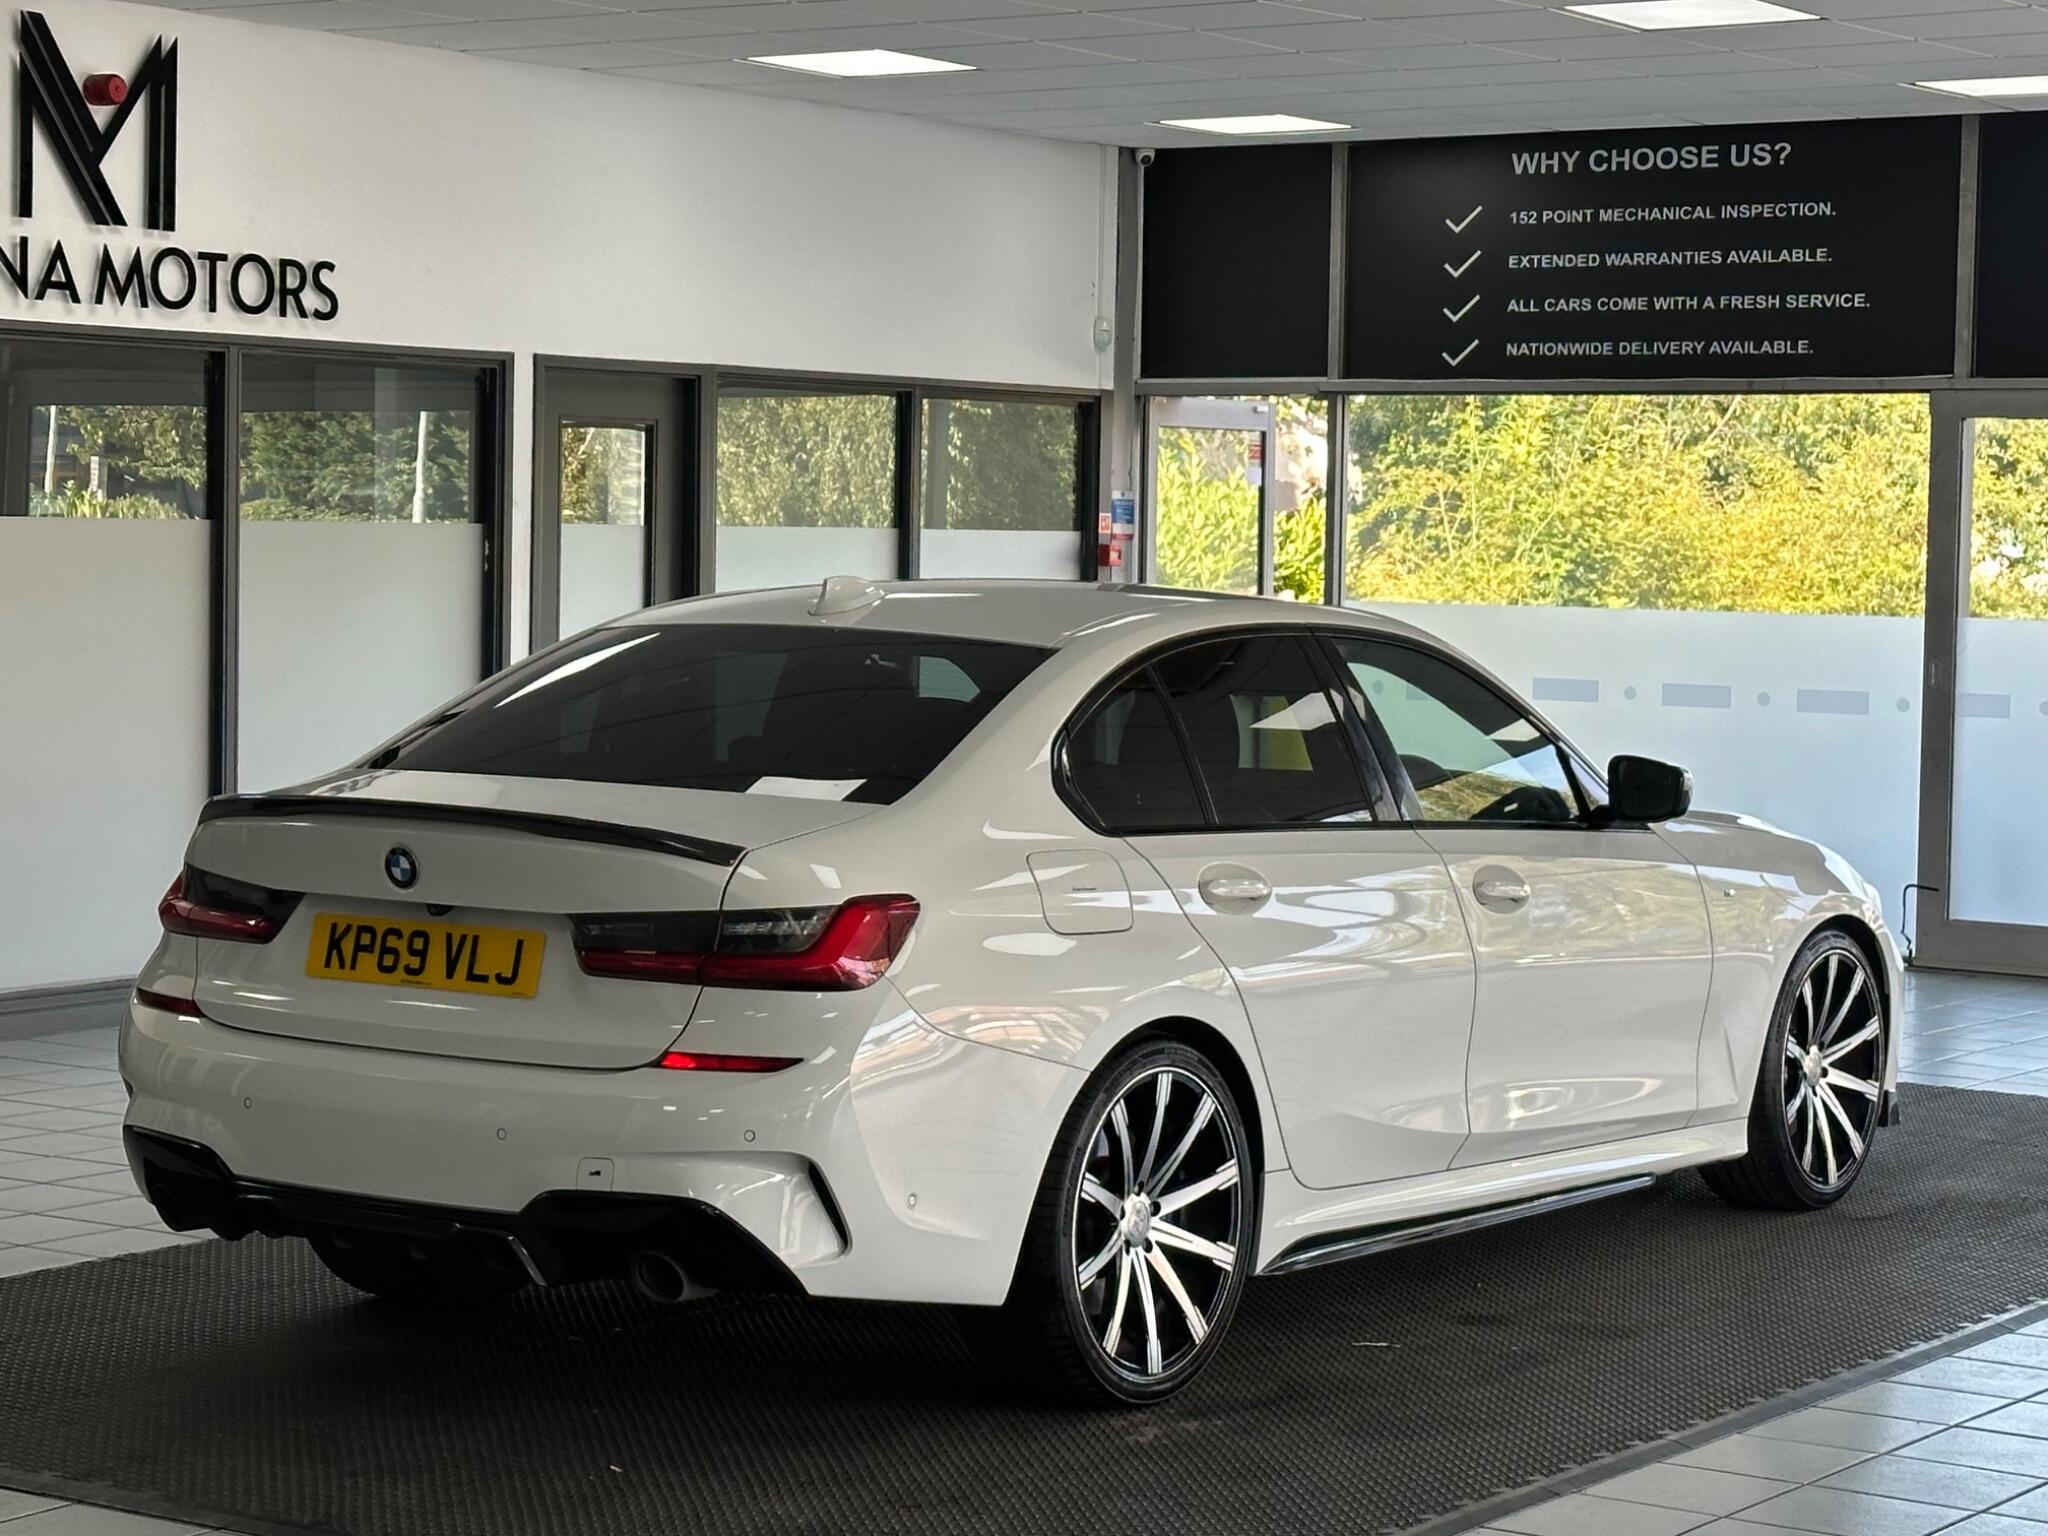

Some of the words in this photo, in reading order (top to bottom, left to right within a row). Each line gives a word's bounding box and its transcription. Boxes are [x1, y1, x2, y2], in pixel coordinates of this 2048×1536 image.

[1511, 150, 1581, 175] WHY
[1588, 145, 1720, 172] CHOOSE
[1730, 142, 1792, 167] US?
[1509, 210, 1538, 225] 152
[1542, 208, 1595, 224] POINT
[1598, 205, 1716, 222] MECHANICAL
[1721, 201, 1836, 219] INSPECTION.
[1508, 253, 1600, 269] EXTENDED
[1605, 250, 1723, 267] WARRANTIES
[1726, 247, 1833, 264] AVAILABLE.
[95, 243, 338, 321] MOTORS
[1506, 298, 1540, 313] ALL
[1544, 297, 1592, 312] CARS
[1596, 296, 1649, 311] COME
[1652, 296, 1698, 311] WITH
[1702, 295, 1715, 310] A
[1719, 294, 1780, 310] FRESH
[1785, 293, 1871, 309] SERVICE.
[1506, 342, 1613, 357] NATIONWIDE
[1618, 340, 1705, 356] DELIVERY
[1708, 339, 1814, 355] AVAILABLE.
[323, 921, 431, 977] KP69
[444, 931, 525, 986] VLJ
